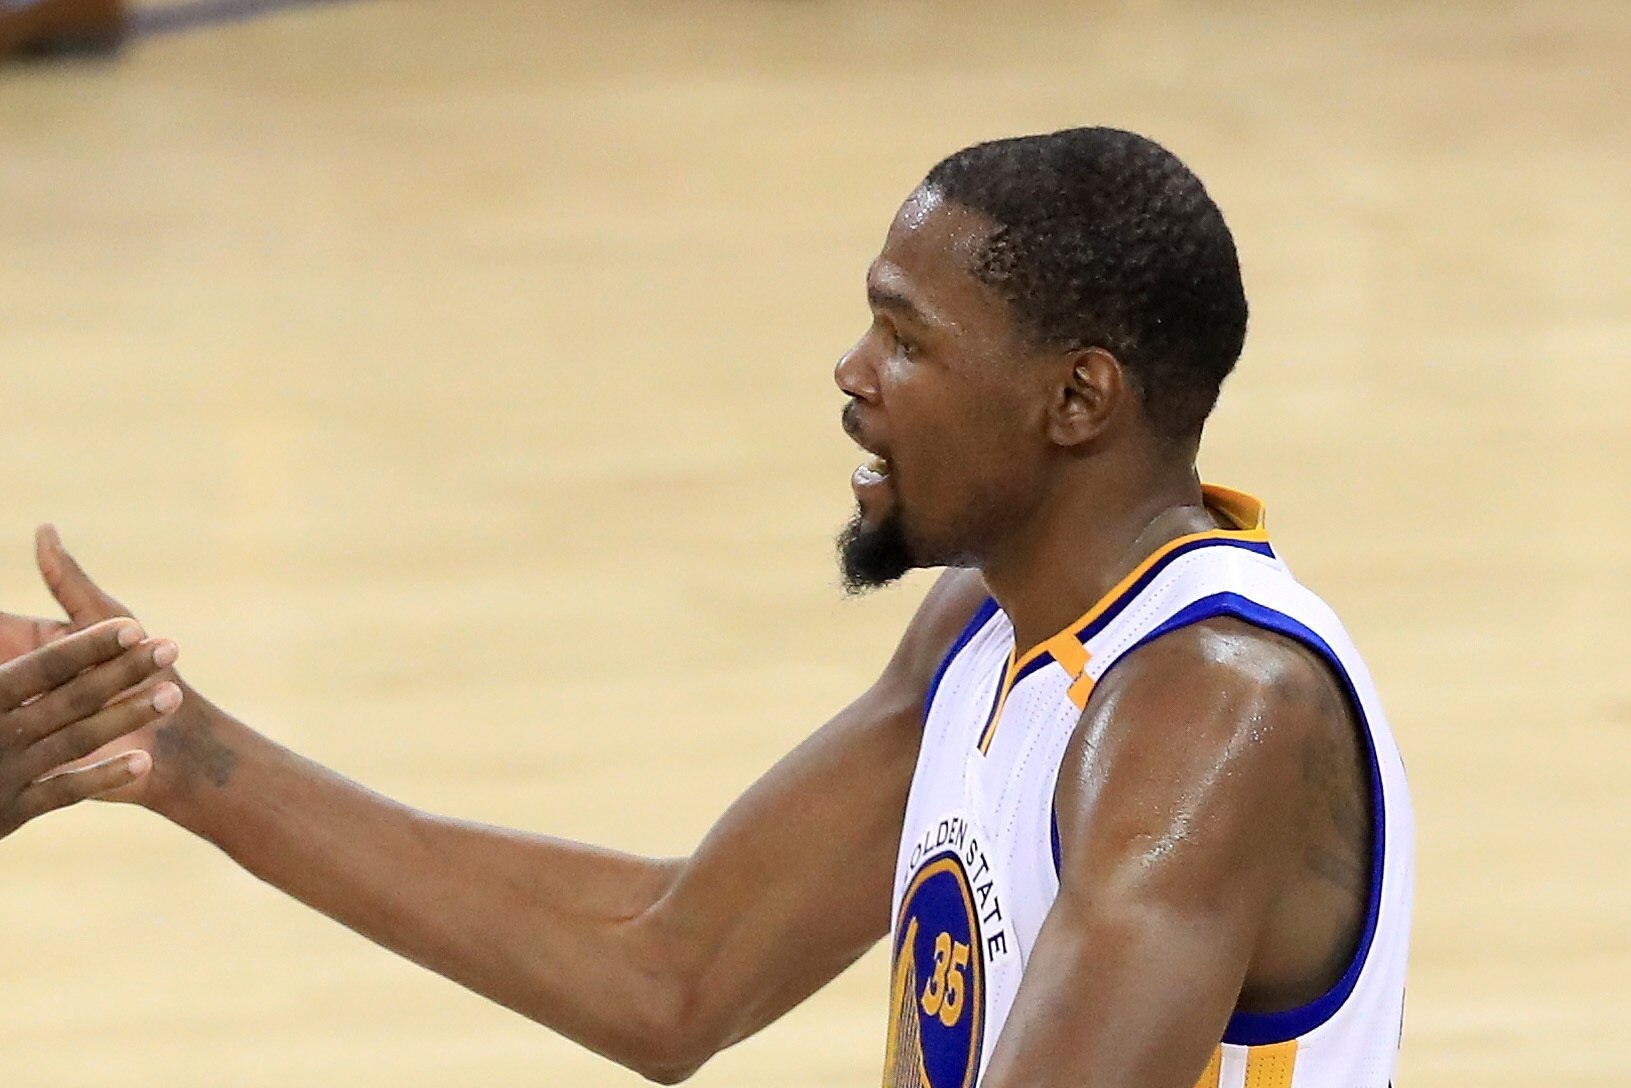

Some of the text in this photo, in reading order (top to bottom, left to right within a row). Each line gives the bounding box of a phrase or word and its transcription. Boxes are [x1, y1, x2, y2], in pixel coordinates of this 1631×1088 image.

[902, 817, 1008, 963] OLDEN STATE
[921, 931, 970, 1028] 35
